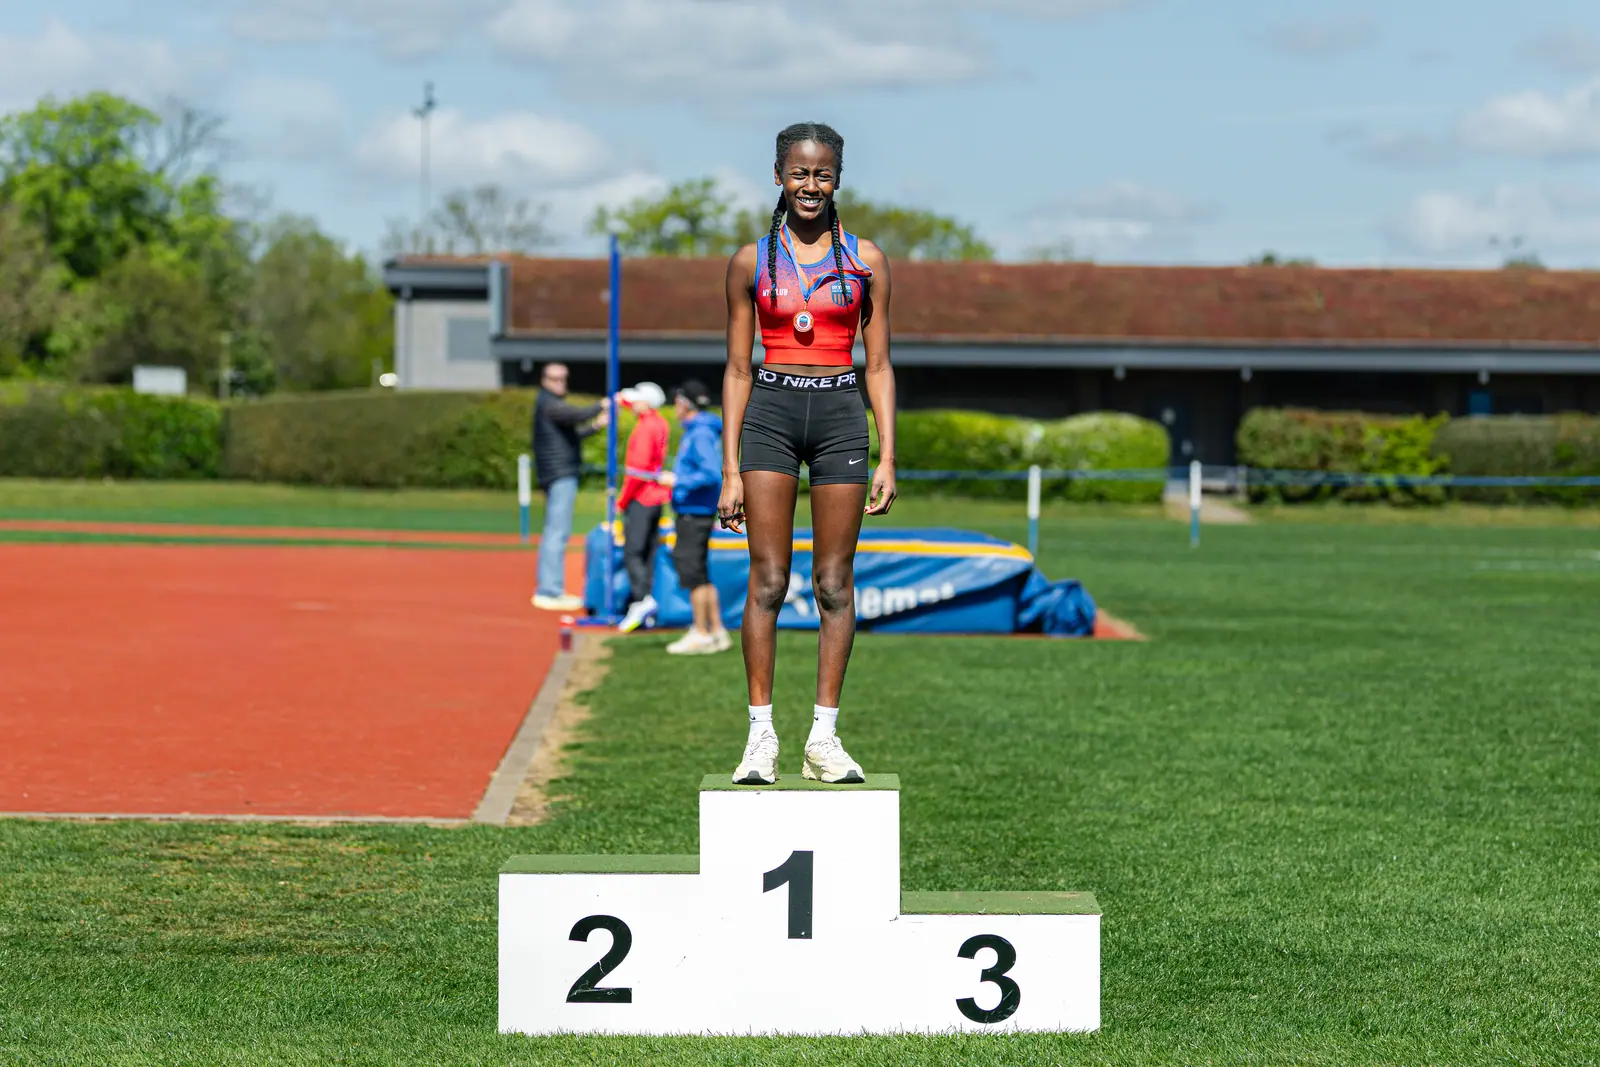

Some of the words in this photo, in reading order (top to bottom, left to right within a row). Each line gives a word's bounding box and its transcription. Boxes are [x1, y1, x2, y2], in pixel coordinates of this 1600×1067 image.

[782, 376, 834, 388] NIKE
[763, 851, 813, 939] 1
[566, 915, 632, 1003] 2
[956, 935, 1020, 1023] 3
